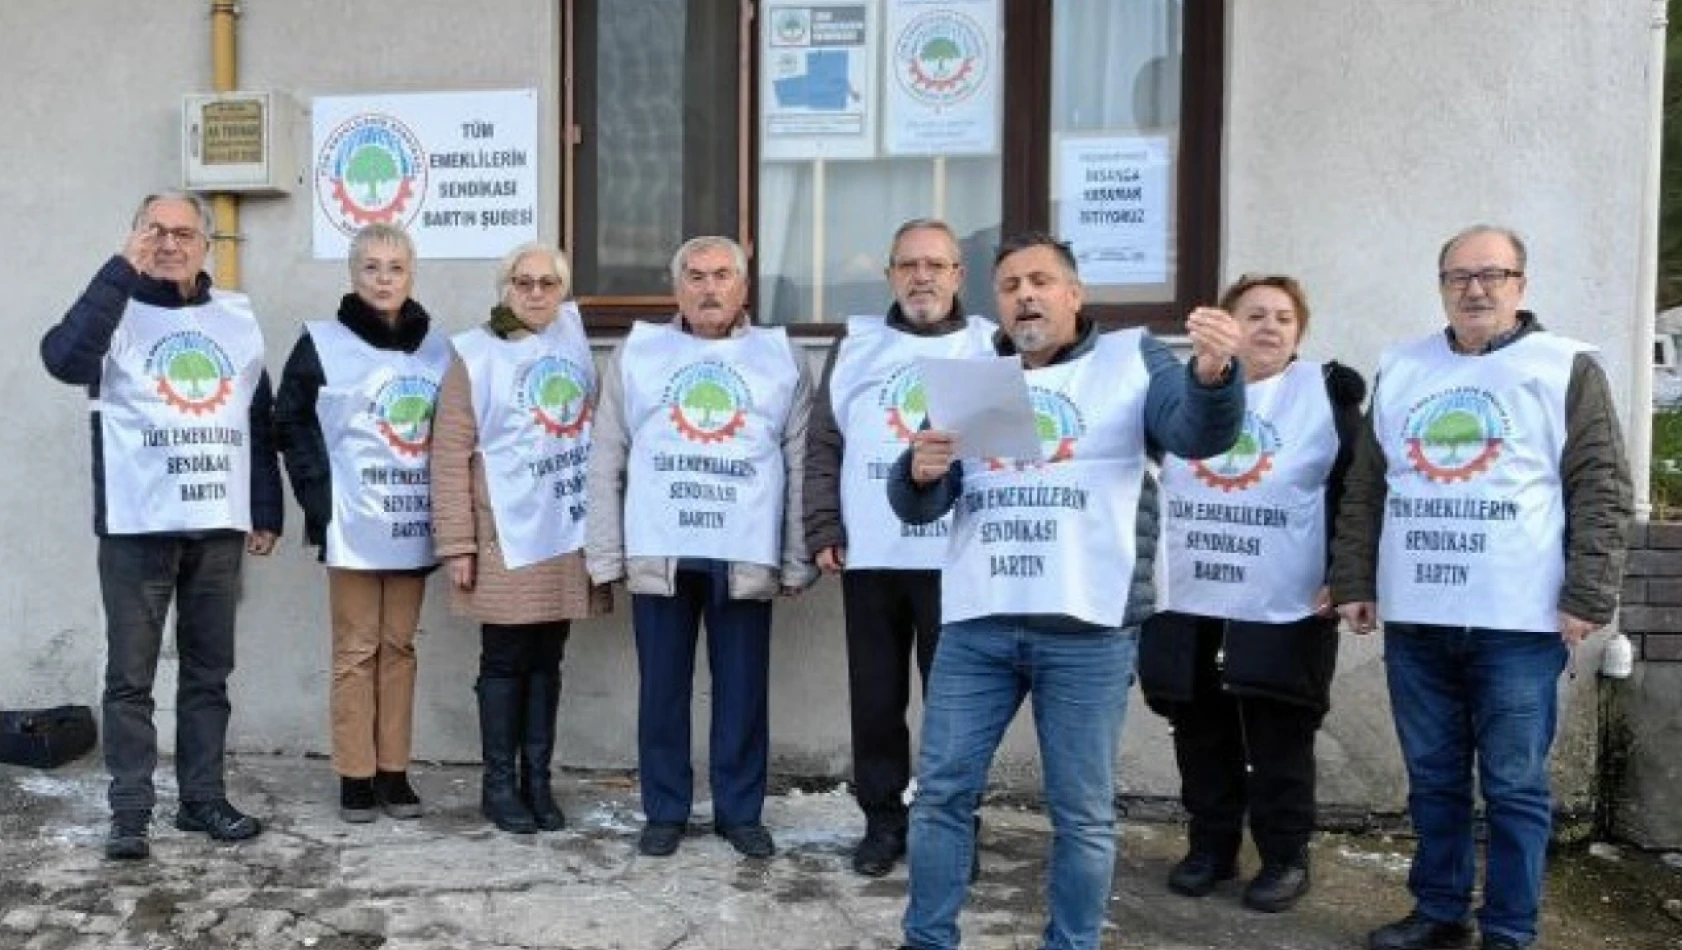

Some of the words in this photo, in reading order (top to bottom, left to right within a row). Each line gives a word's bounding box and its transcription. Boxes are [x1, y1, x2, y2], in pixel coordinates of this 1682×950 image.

[461, 120, 494, 139] TÜM
[429, 149, 527, 168] EMEKLİLERİN
[438, 180, 517, 198] SENDİKASI
[423, 210, 476, 227] BARTIN
[481, 204, 533, 230] ŞUBESİ
[141, 424, 169, 447] TÜM
[179, 483, 227, 502] BARTIN
[669, 480, 737, 502] SENDİKASI
[987, 481, 1089, 510] EMEKLİLERİN
[1169, 500, 1194, 518] TÜM
[1196, 503, 1288, 527] EMEKLİLERİN
[1389, 497, 1412, 518] TÜM
[1414, 495, 1517, 520] EMEKLİLERİN
[678, 511, 726, 529] BARTIN
[981, 515, 1057, 544] SENDİKASI
[1186, 529, 1261, 556] SENDİKASI
[1405, 527, 1486, 553] SENDİKASI
[990, 555, 1046, 578] BARTIN
[1194, 560, 1246, 582] BARTIN
[1414, 563, 1468, 586] BARTIN
